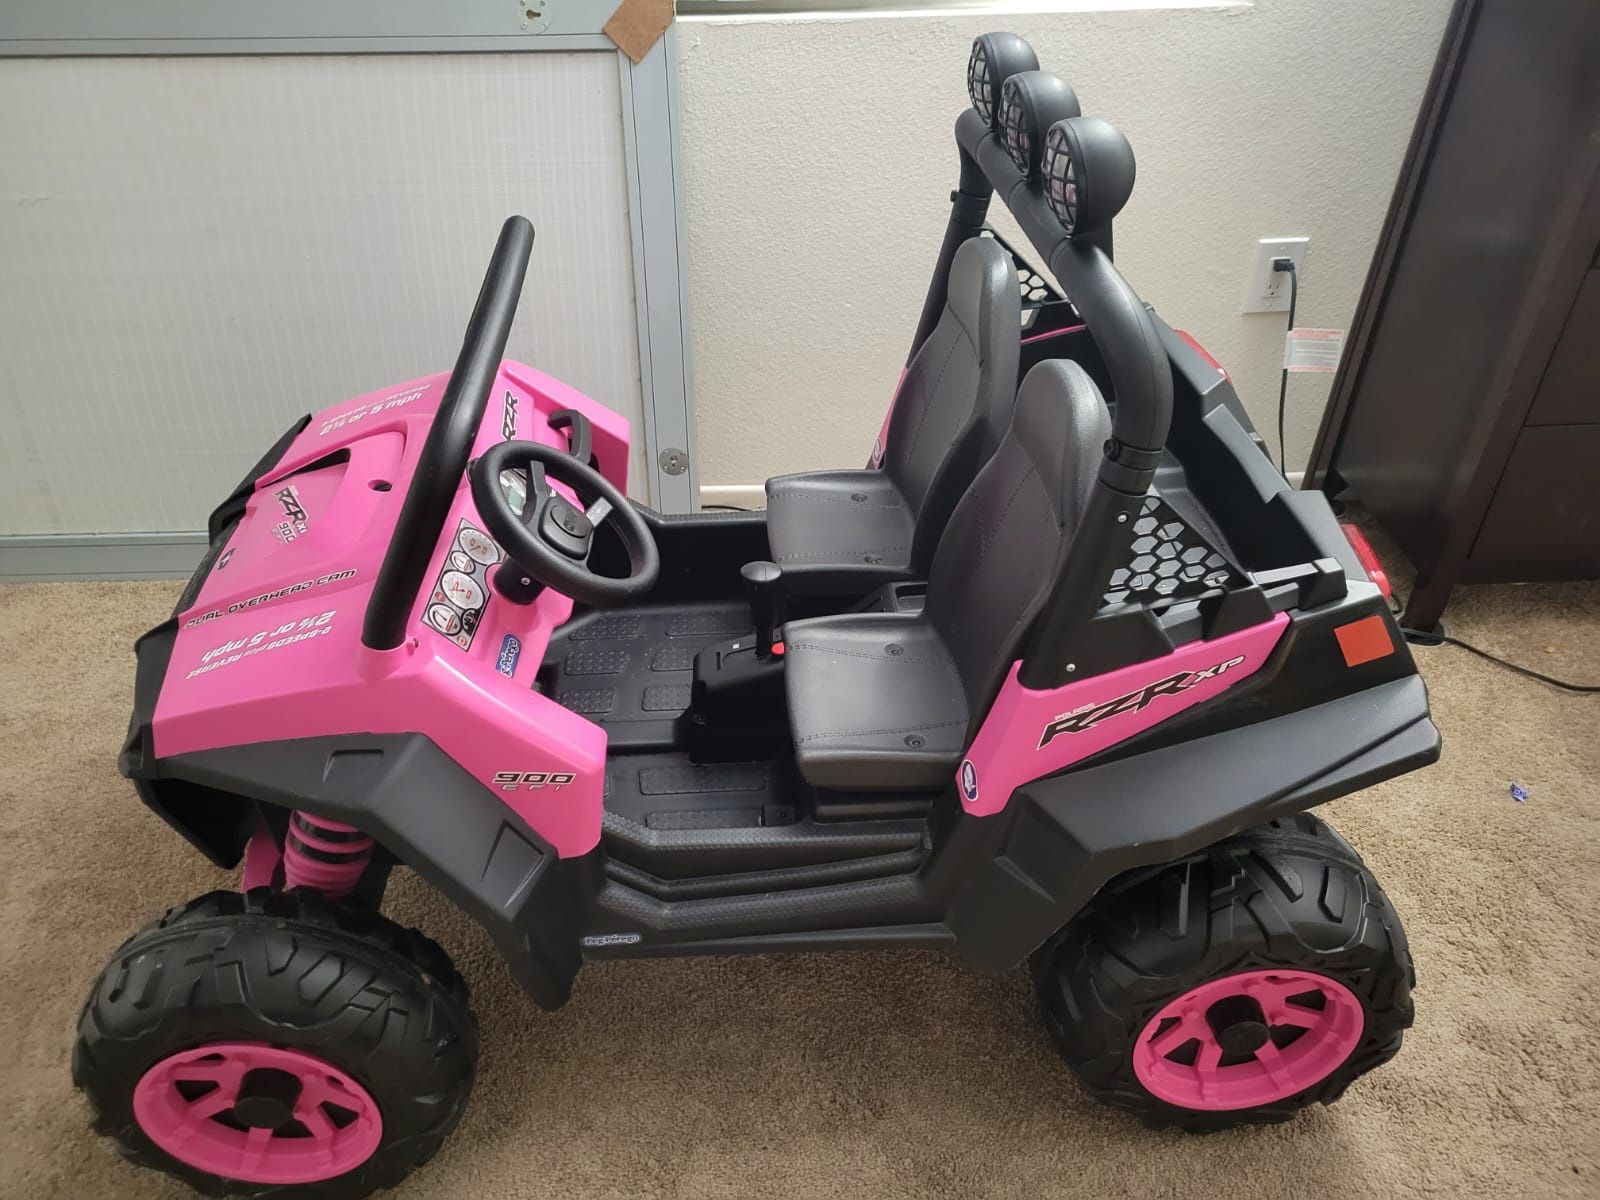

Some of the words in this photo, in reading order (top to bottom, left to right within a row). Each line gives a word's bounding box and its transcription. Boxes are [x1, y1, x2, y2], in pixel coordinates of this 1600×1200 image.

[385, 392, 422, 409] mph
[500, 389, 520, 442] RZR
[273, 486, 309, 526] RZR
[184, 610, 225, 629] DUAL
[227, 580, 315, 614] OVERHEAD
[316, 568, 358, 587] CAM
[246, 631, 268, 648] 5
[268, 621, 297, 638] or
[201, 637, 249, 663] mph
[1036, 670, 1196, 751] RZR
[1192, 655, 1245, 684] XP
[491, 771, 577, 785] 900
